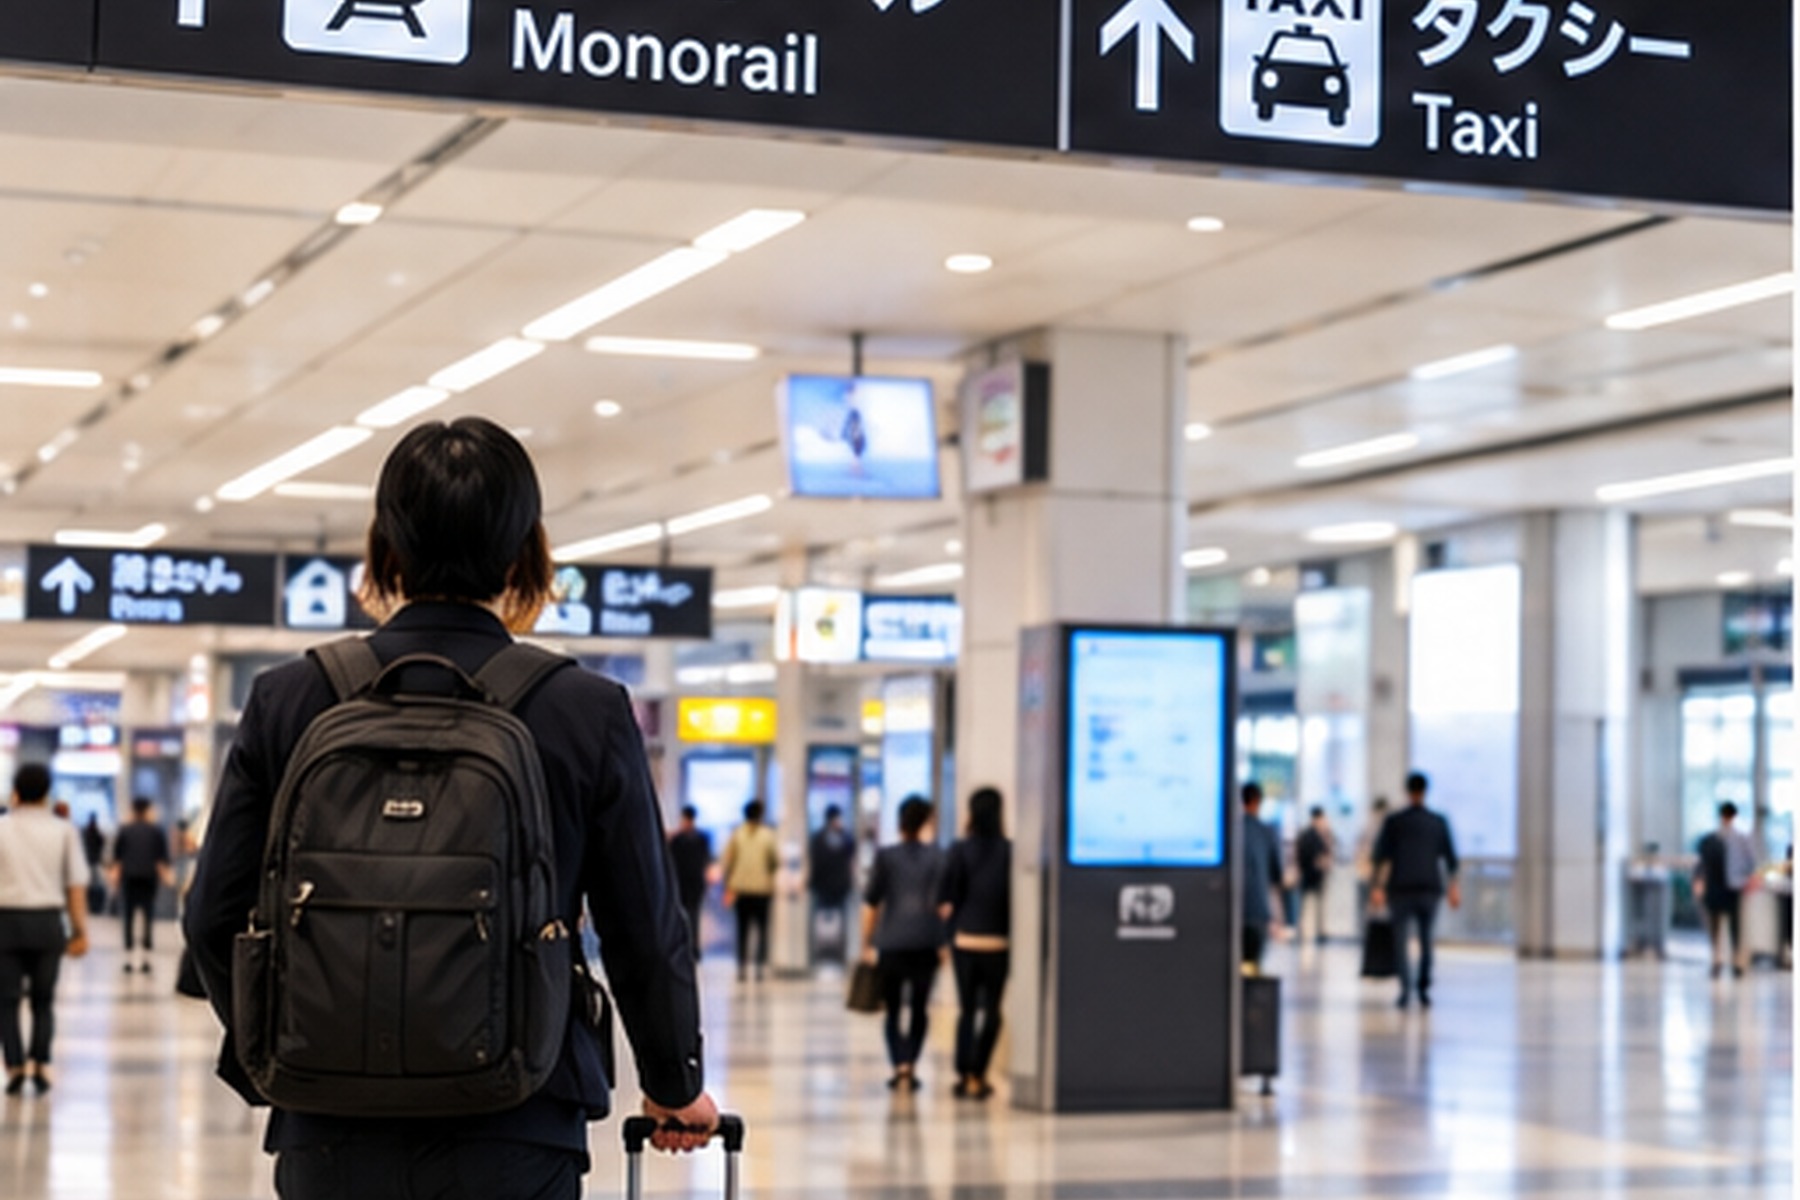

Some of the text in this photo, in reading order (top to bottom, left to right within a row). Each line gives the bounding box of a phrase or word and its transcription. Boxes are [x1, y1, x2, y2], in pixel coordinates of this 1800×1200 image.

[512, 8, 817, 94] Monorail
[1412, 0, 1691, 77] タクシー
[1412, 92, 1538, 158] Taxi
